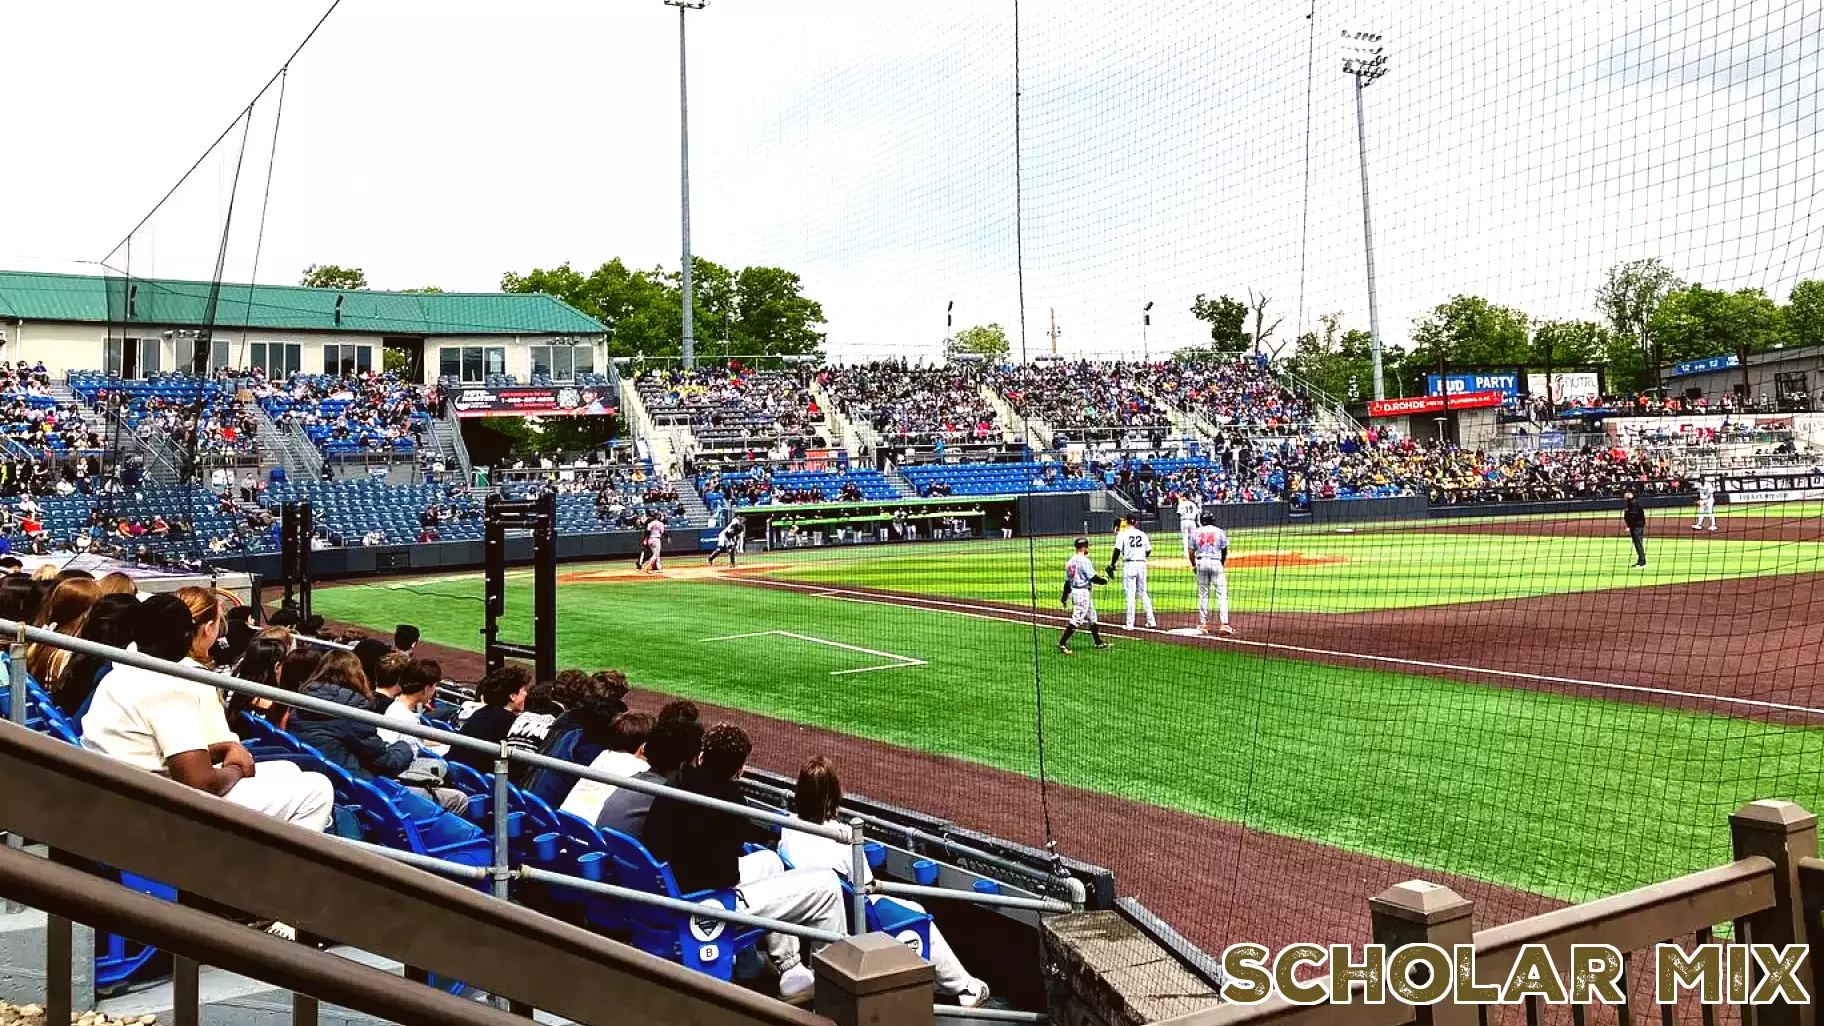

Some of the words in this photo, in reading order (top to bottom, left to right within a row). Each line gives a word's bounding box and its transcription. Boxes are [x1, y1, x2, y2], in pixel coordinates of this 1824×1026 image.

[1476, 376, 1515, 389] PARTY
[1128, 535, 1143, 548] 22
[706, 948, 713, 957] B
